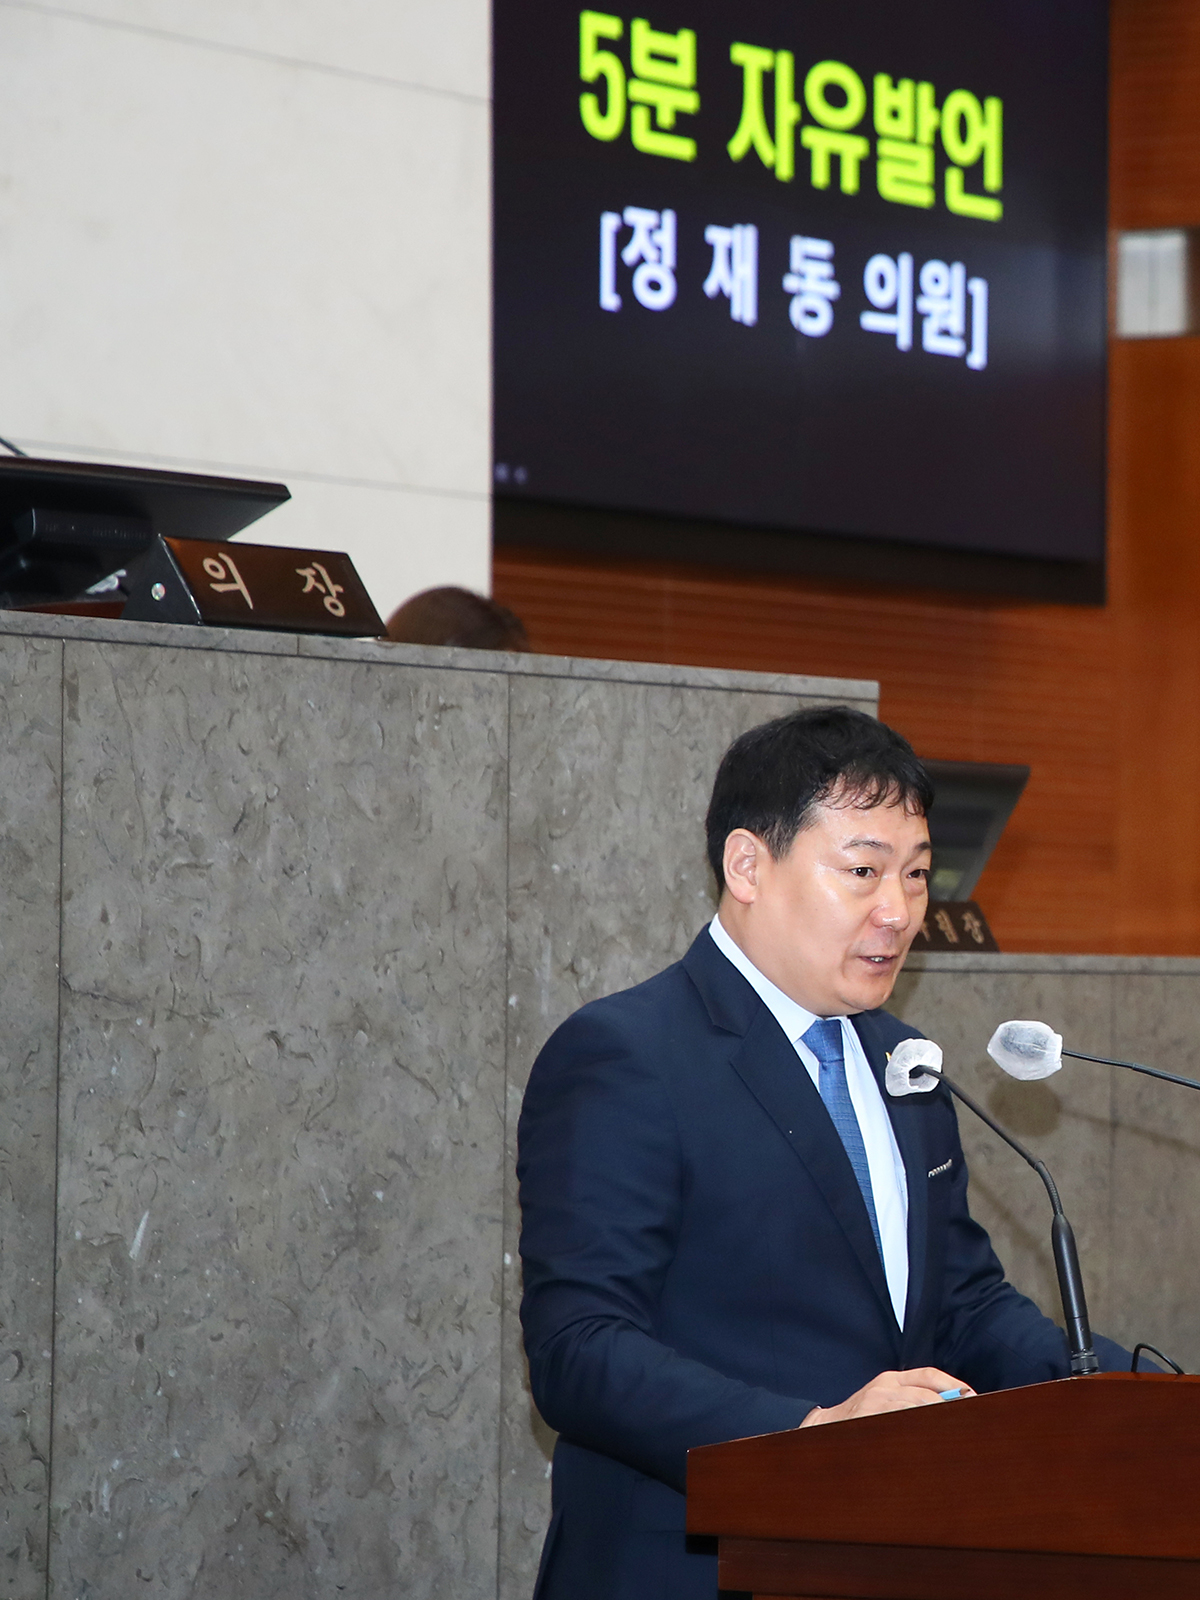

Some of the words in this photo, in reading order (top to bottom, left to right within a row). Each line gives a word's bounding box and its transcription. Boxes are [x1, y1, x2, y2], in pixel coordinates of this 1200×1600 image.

[579, 9, 700, 163] 5분
[726, 41, 1003, 222] 자유발언
[600, 205, 677, 312] [정
[703, 223, 758, 327] 재
[783, 234, 840, 337] 동
[859, 251, 989, 371] 의원]
